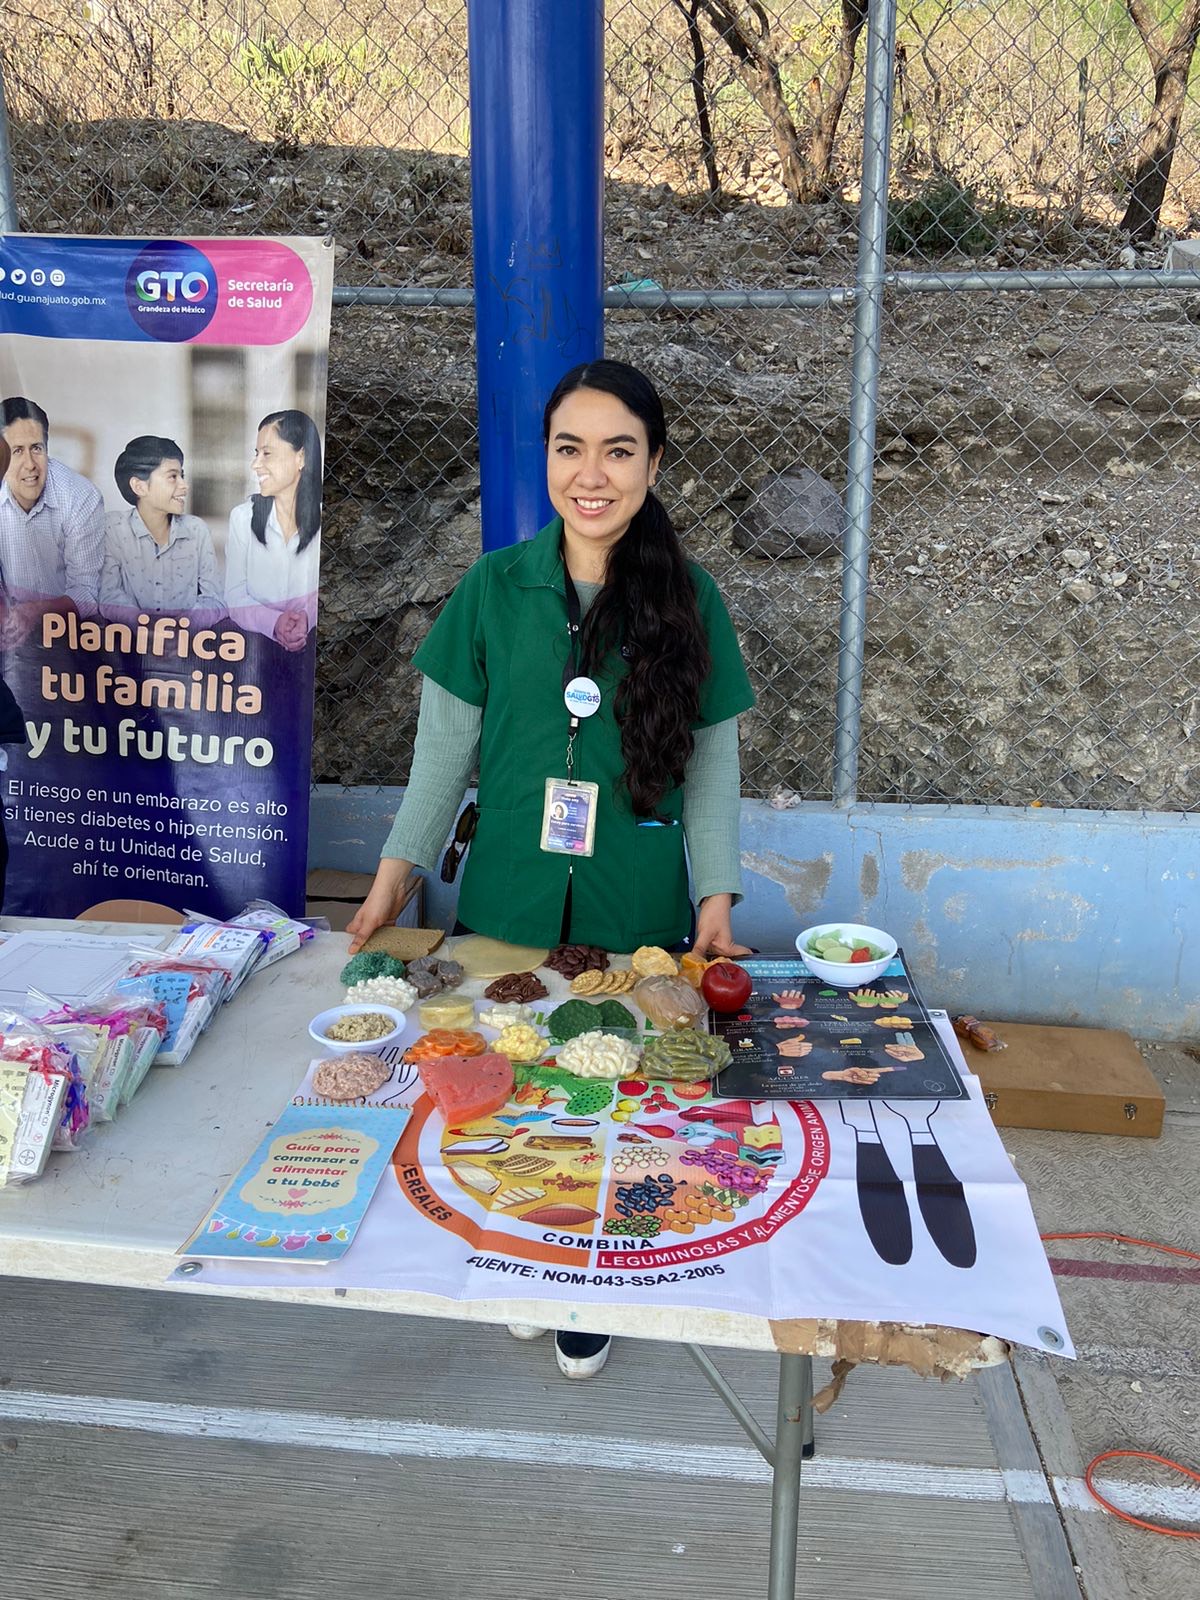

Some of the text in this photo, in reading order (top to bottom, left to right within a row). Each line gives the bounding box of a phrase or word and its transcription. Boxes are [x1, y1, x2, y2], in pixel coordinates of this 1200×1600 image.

[136, 270, 209, 302] GTO
[228, 279, 294, 292] Secretaría
[138, 305, 171, 313] Grandeza
[181, 305, 206, 314] México
[228, 296, 282, 308] de Salud
[42, 611, 246, 662] Planifica
[41, 665, 263, 715] tu familia
[25, 718, 275, 767] y tu futuro
[8, 779, 288, 816] El riesgo en un embarazo es alto
[4, 805, 288, 842] si tienes diabetes o hipertensión.
[24, 830, 266, 868] Acude a tu Unidad de Salud,
[72, 859, 209, 888] ahí te orientaran.
[46, 1079, 60, 1115] Microgynon
[273, 1154, 346, 1164] comenzar
[285, 1143, 361, 1153] Guía para
[272, 1165, 348, 1176] alimentar
[281, 1177, 298, 1186] tu
[301, 1177, 341, 1188] bebé
[601, 1236, 740, 1267] LEGUMINOSAS
[739, 1231, 752, 1241] Y
[753, 1172, 815, 1239] ALIMENTOS
[809, 1127, 825, 1167] ORIGEN
[542, 1232, 655, 1250] COMBINA
[542, 1263, 726, 1287] NOM-043-SSA2-2005
